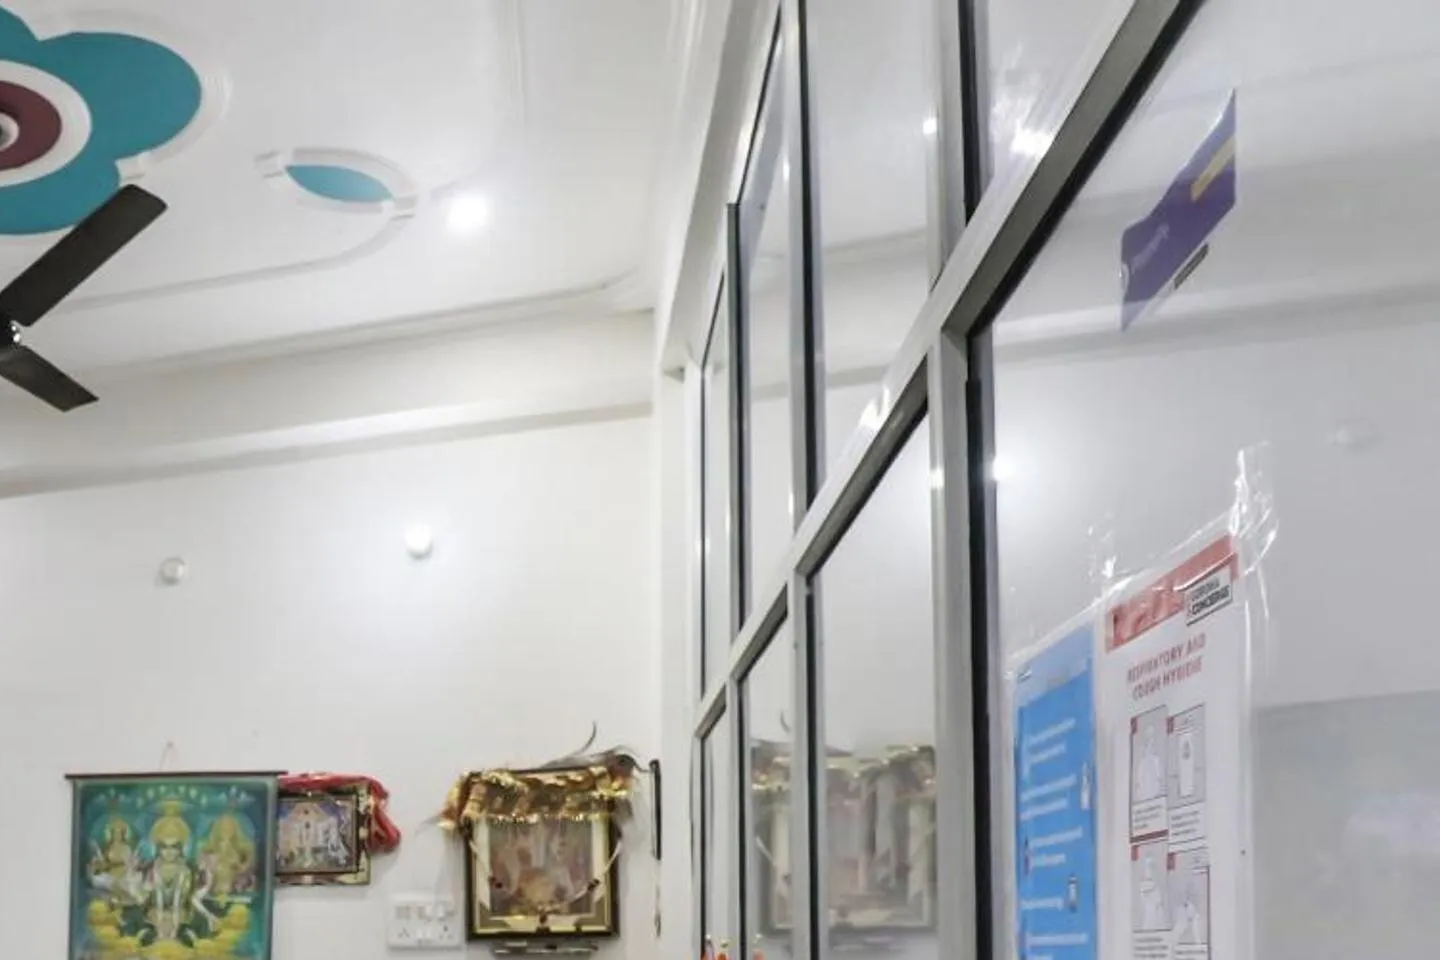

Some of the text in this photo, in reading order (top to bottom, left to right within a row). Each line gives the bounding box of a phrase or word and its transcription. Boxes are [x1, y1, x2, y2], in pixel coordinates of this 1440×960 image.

[1186, 632, 1206, 655] AND
[1132, 656, 1203, 701] COUGH HYGIENE
